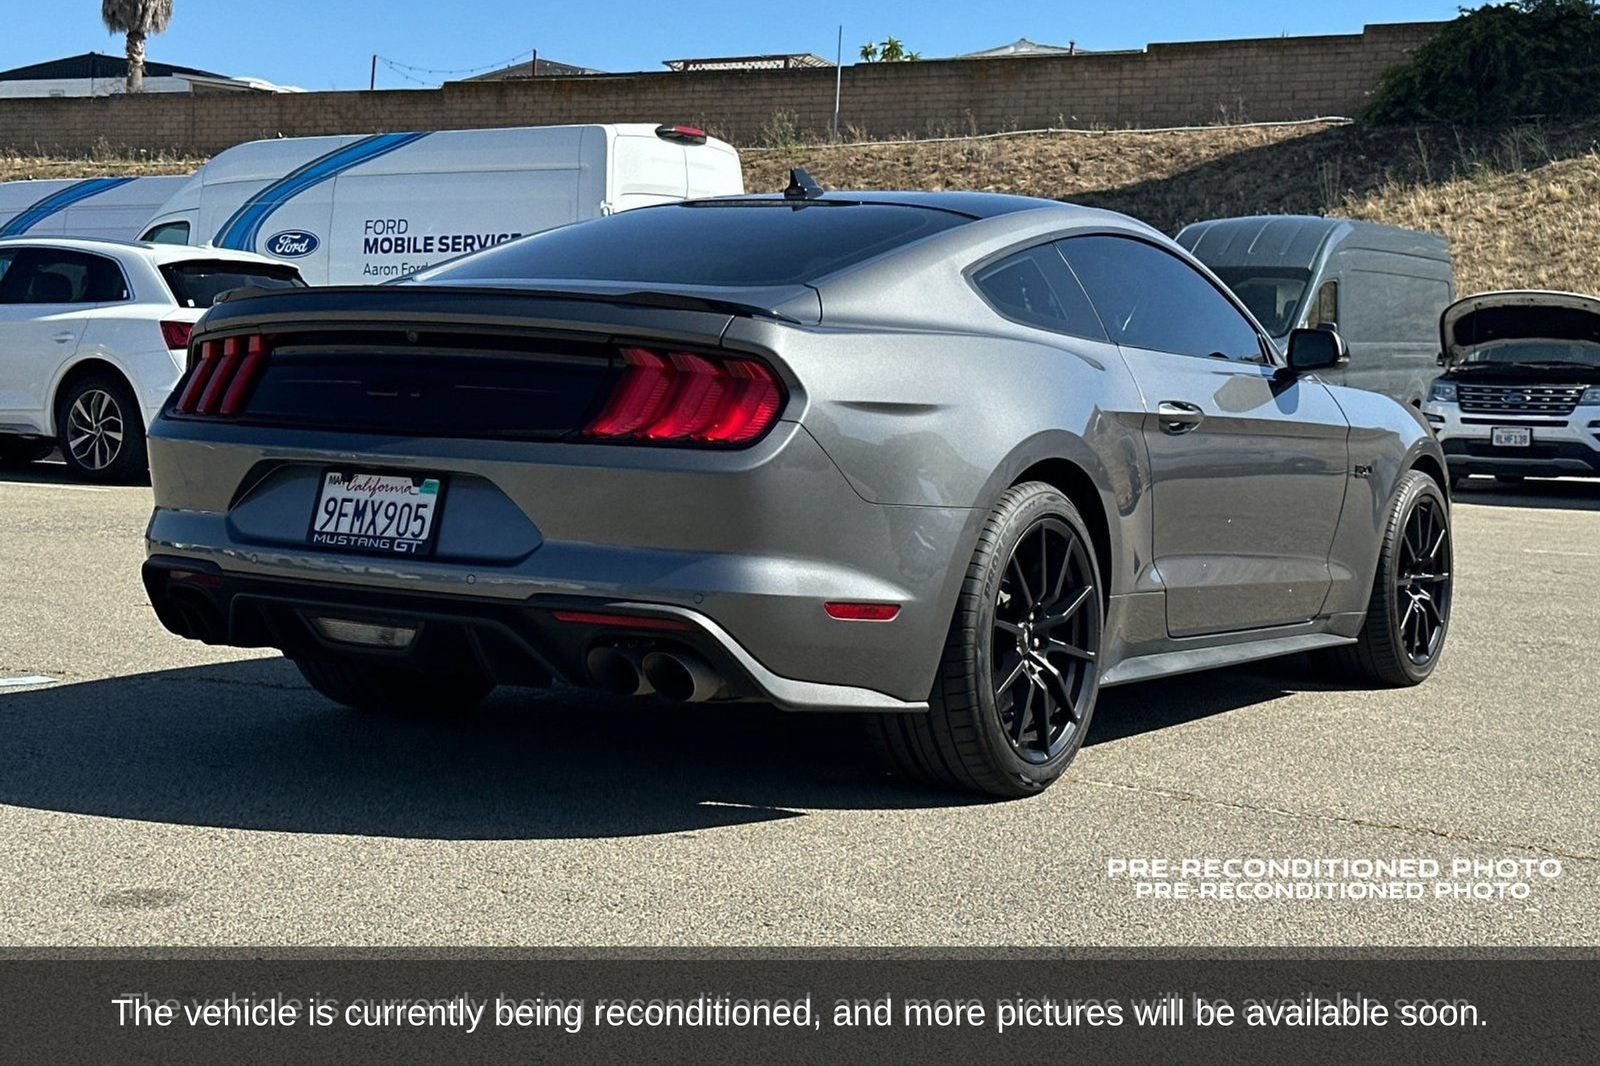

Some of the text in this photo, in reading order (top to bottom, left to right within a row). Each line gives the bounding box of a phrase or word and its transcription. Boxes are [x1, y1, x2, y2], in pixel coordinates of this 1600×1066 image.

[364, 218, 409, 235] FORD
[275, 234, 309, 253] Ford
[363, 236, 434, 255] MOBILE
[362, 262, 399, 276] Aaron
[345, 474, 419, 498] California
[319, 497, 428, 538] 9FMX905
[313, 533, 423, 553] MUSTANG GT
